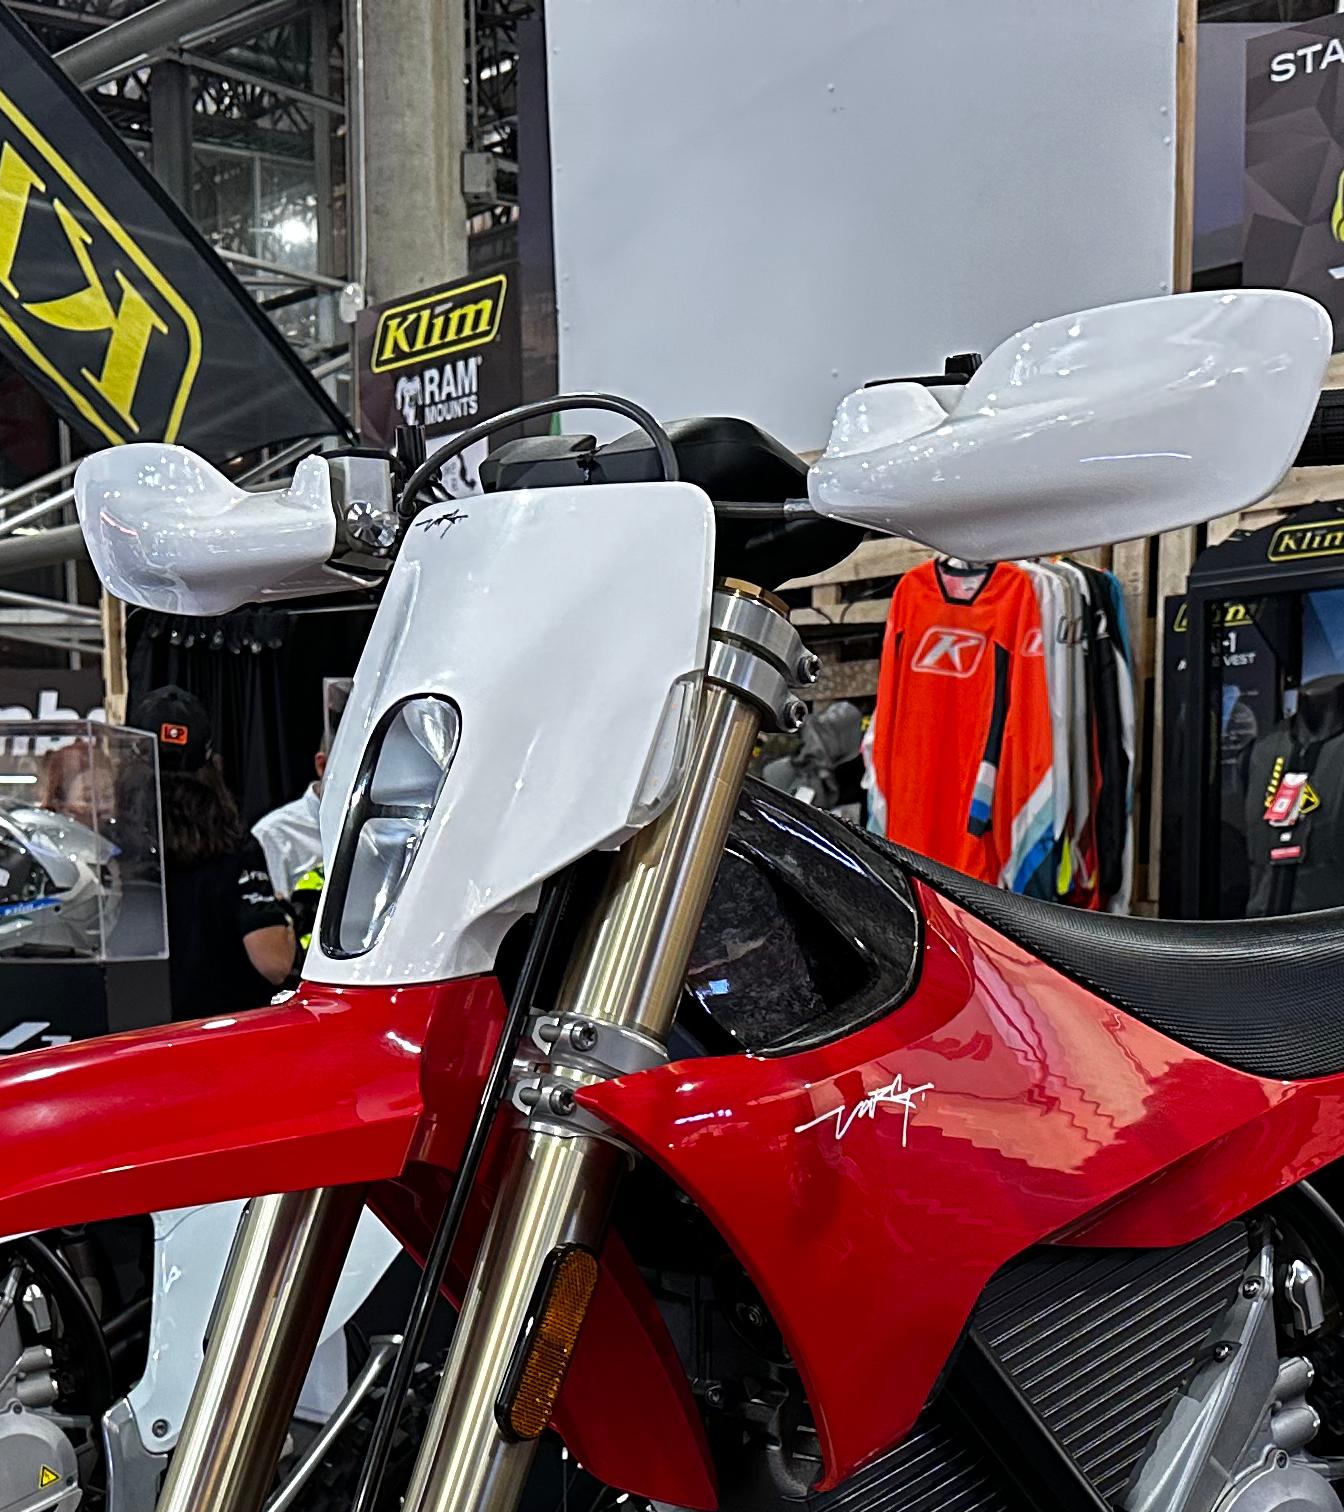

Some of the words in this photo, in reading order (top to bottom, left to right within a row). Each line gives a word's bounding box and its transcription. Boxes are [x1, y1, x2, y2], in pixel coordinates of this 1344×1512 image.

[378, 299, 494, 361] Klim
[422, 356, 479, 405] RAM
[424, 394, 479, 426] MOUNTS
